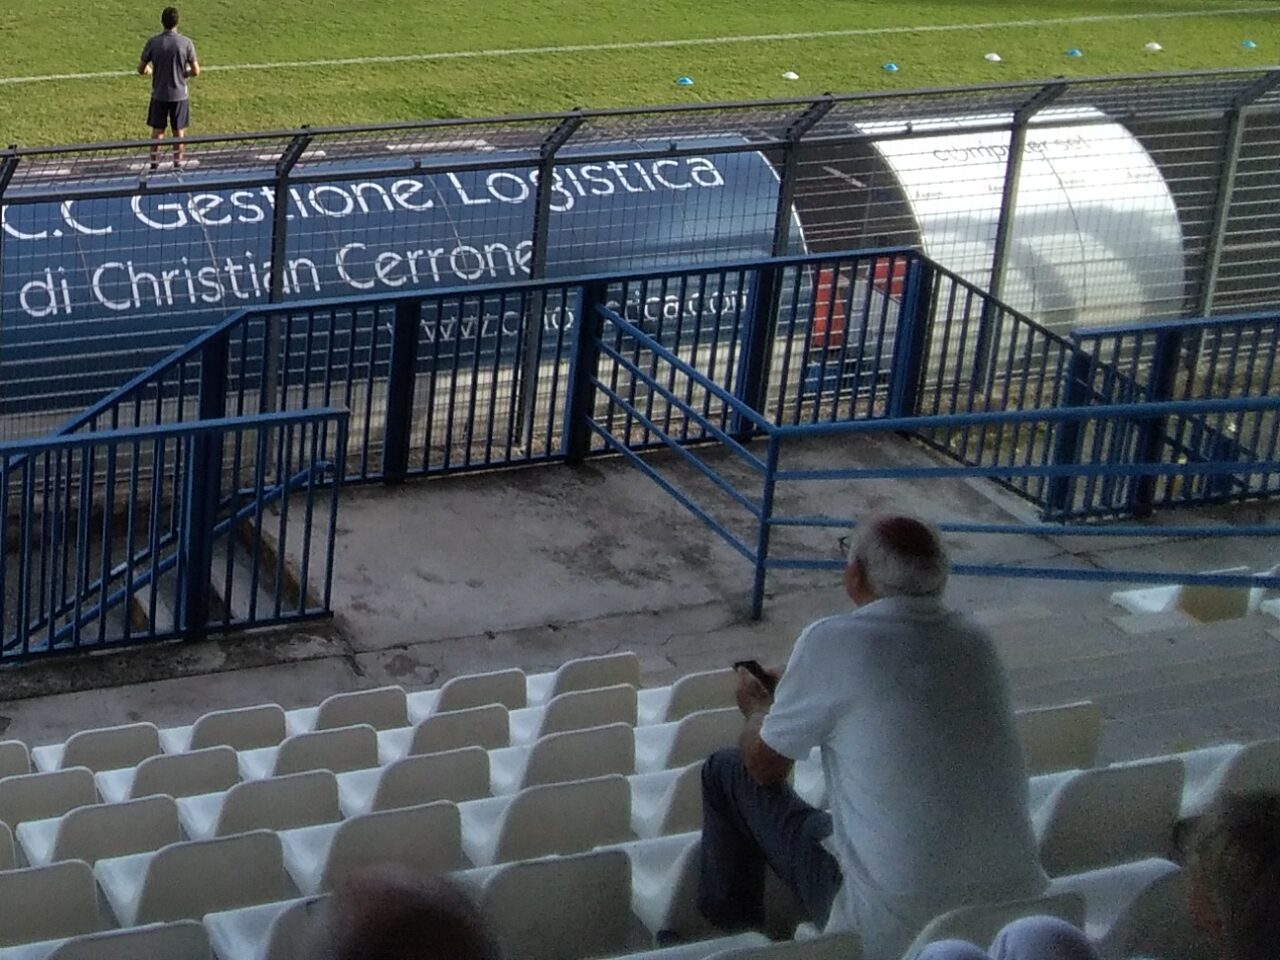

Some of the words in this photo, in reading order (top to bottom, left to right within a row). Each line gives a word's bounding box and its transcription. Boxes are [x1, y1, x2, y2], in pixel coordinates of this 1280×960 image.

[1, 198, 114, 240] C.C
[131, 178, 434, 231] Gestione
[446, 156, 725, 212] Logistica
[19, 265, 72, 318] di
[92, 249, 321, 311] Christian
[334, 240, 535, 290] Cerrone
